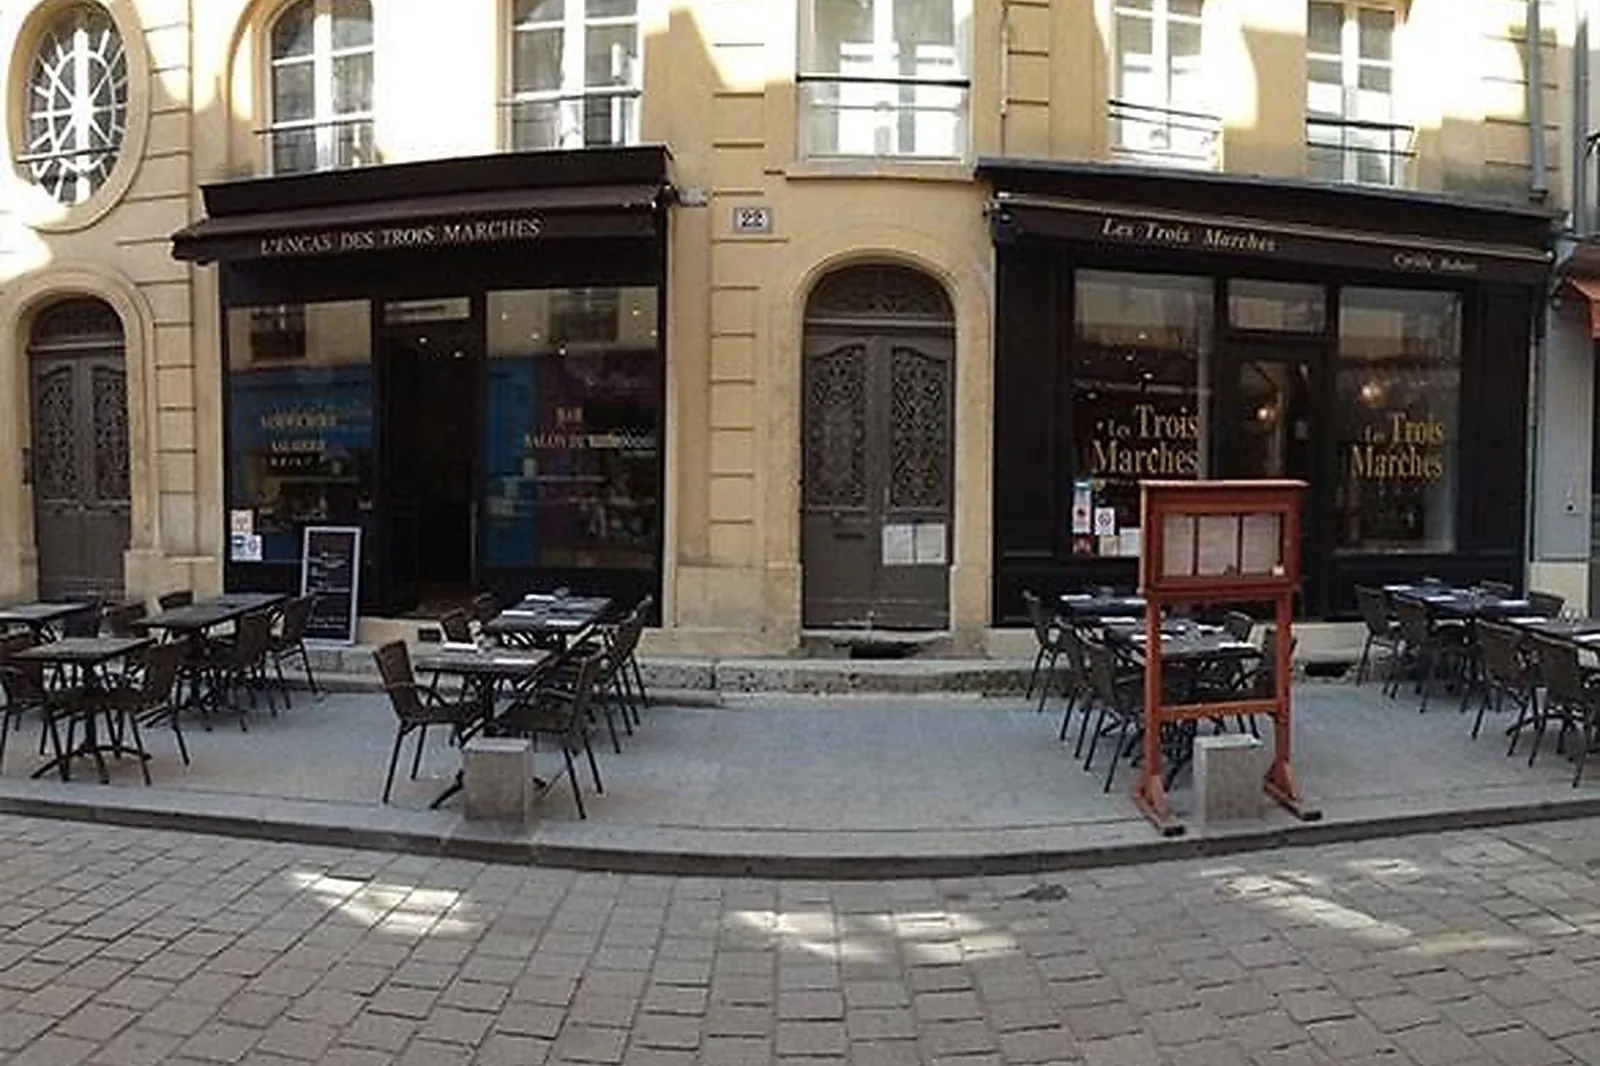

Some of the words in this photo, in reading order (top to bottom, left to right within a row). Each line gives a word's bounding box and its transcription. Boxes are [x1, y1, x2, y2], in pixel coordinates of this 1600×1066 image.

[341, 230, 375, 251] DES
[381, 226, 436, 246] TROIS
[443, 218, 541, 241] MARCHES
[1146, 222, 1190, 243] Trois
[1203, 228, 1275, 252] Marches
[1134, 403, 1199, 439] Trois
[1386, 411, 1444, 443] Trois
[1091, 439, 1199, 474] Marches
[1351, 445, 1444, 479] Marches
